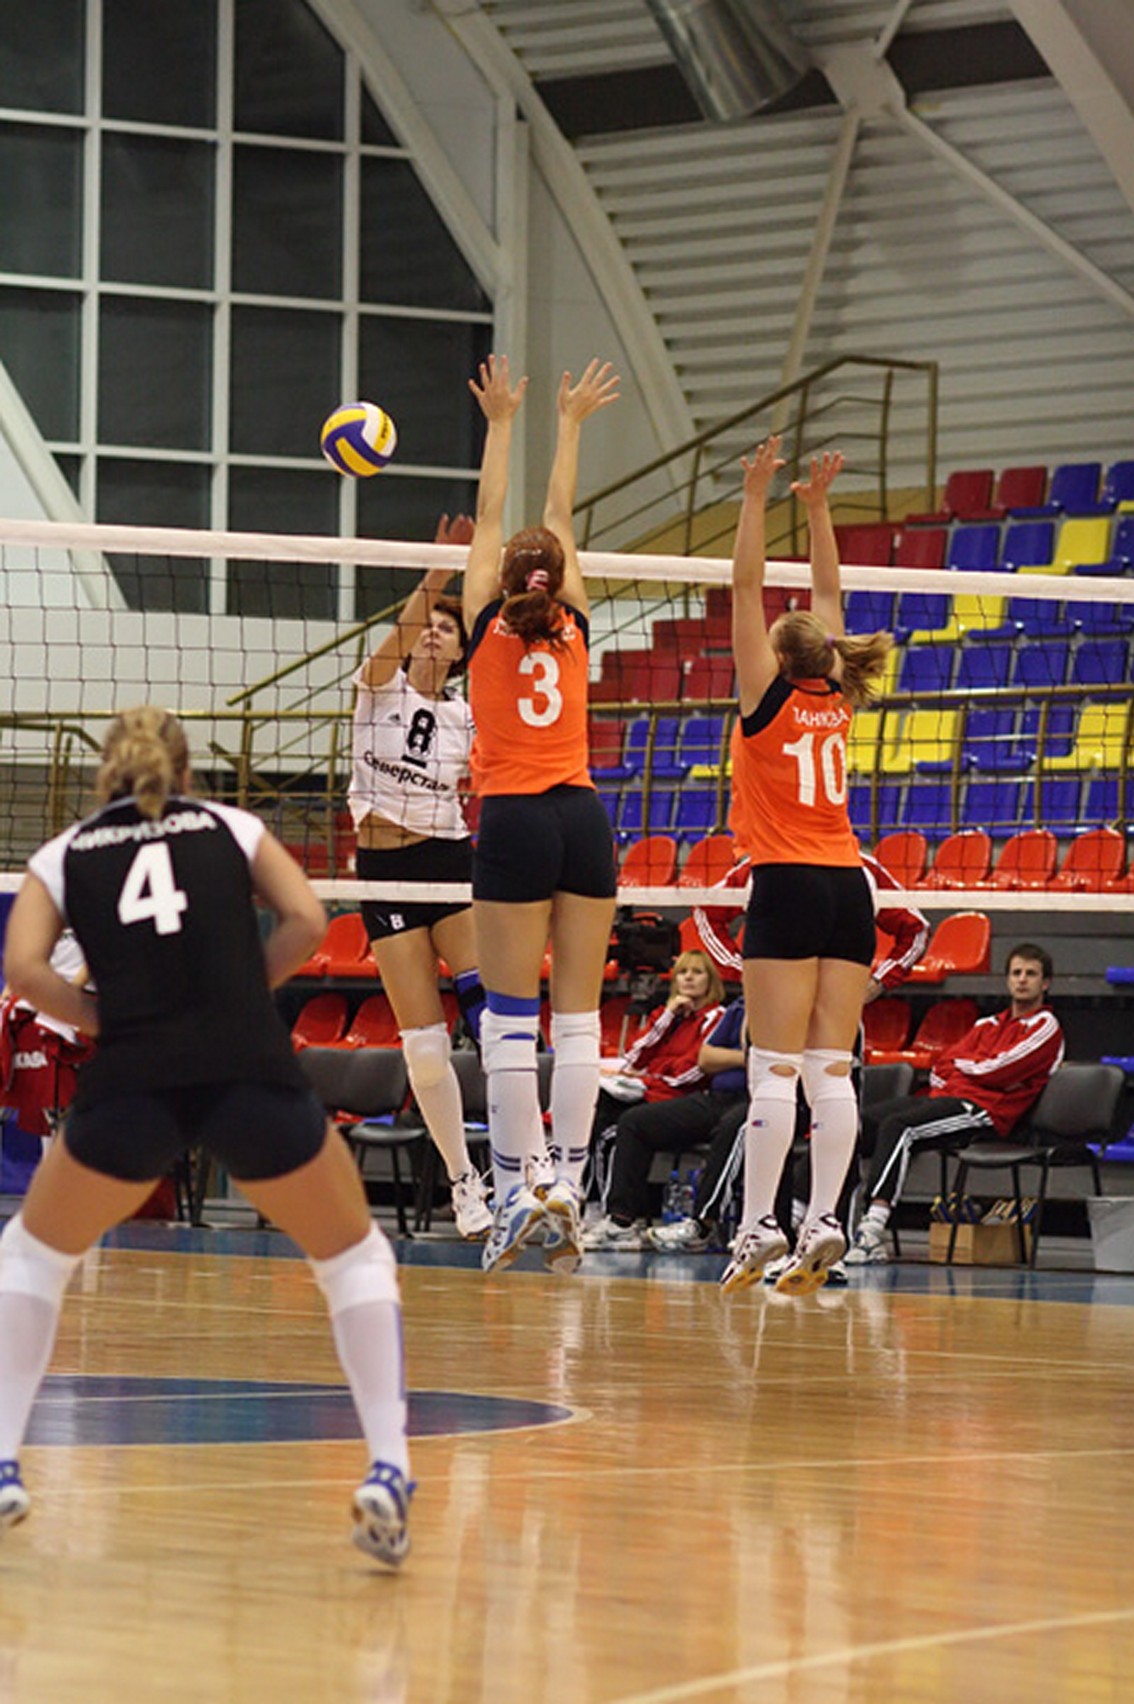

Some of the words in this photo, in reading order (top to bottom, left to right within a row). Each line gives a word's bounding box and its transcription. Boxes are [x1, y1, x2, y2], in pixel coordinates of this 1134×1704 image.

[518, 651, 562, 727] 3
[407, 708, 437, 756] 8
[783, 731, 847, 807] 10
[118, 841, 187, 936] 4
